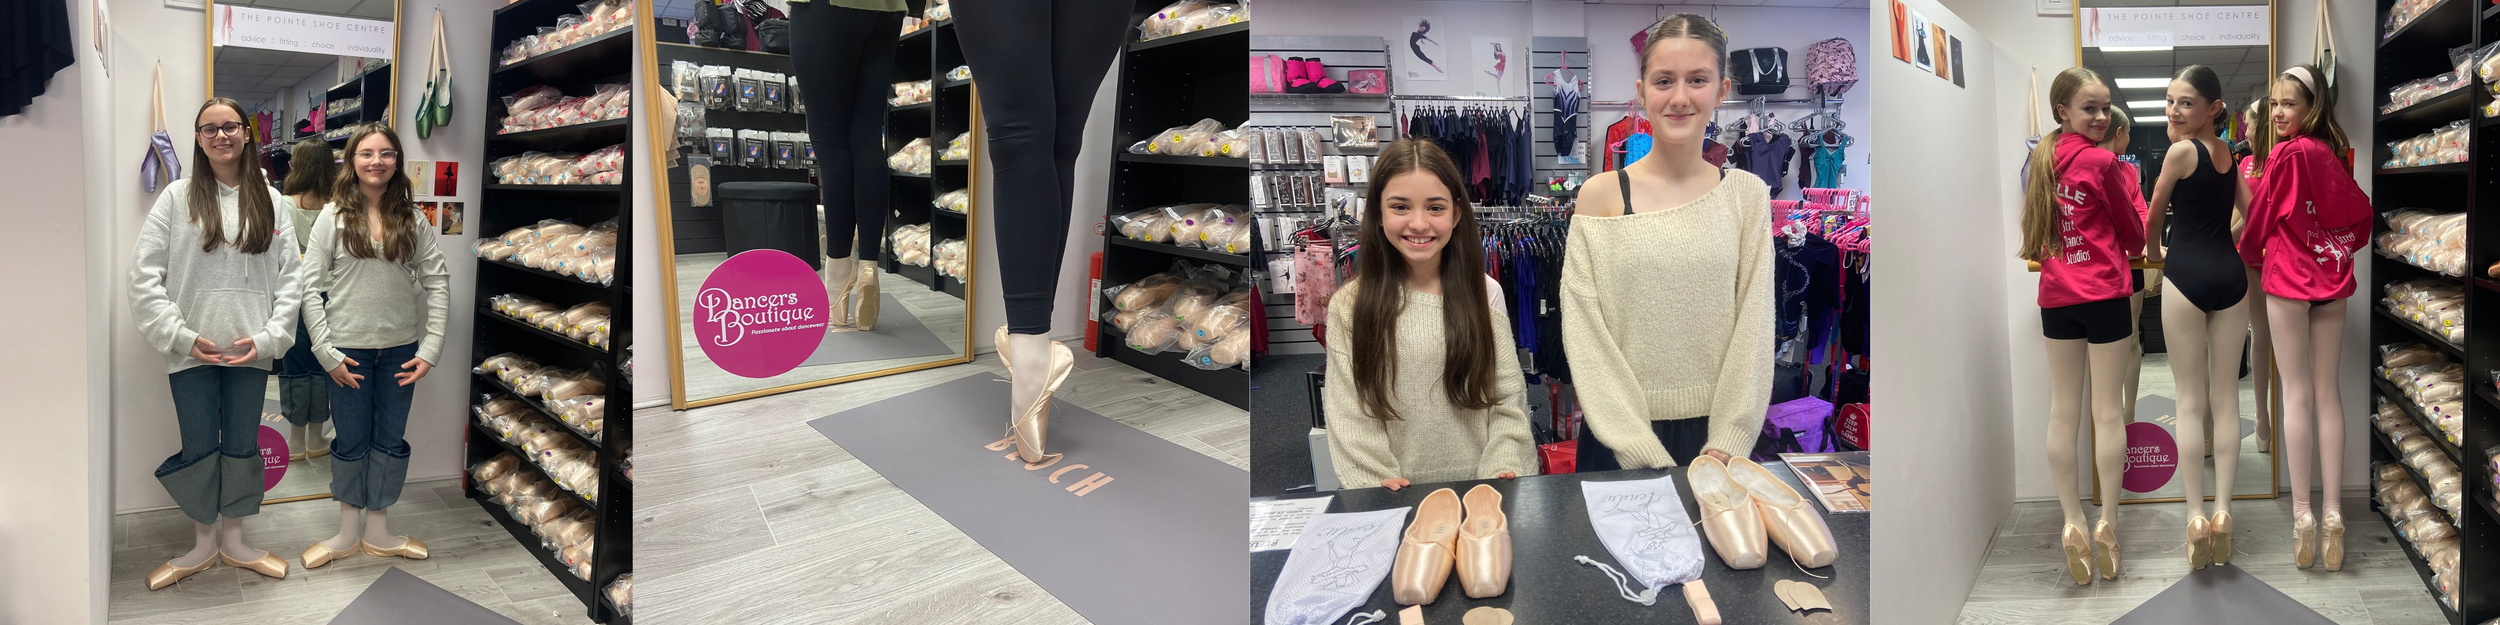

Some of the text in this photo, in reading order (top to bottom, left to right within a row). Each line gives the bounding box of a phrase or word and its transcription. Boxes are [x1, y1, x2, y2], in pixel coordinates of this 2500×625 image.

[241, 13, 386, 34] THE POINTE SHOE CENTRE
[2107, 11, 2260, 21] THE POINTE SHOE CENTRE
[241, 34, 266, 44] advice
[279, 37, 299, 48] fitting
[311, 40, 335, 50] choice
[347, 43, 386, 55] individuality
[2108, 33, 2134, 42] advice
[2147, 33, 2168, 43] fitting
[2180, 33, 2206, 41] choice
[2218, 32, 2261, 41] individuality
[2066, 250, 2091, 265] Studios
[698, 287, 798, 323] Dancers
[713, 307, 814, 347] Boutique
[751, 327, 781, 335] Passionate
[797, 322, 825, 330] dancewear
[2126, 446, 2161, 455] ancers
